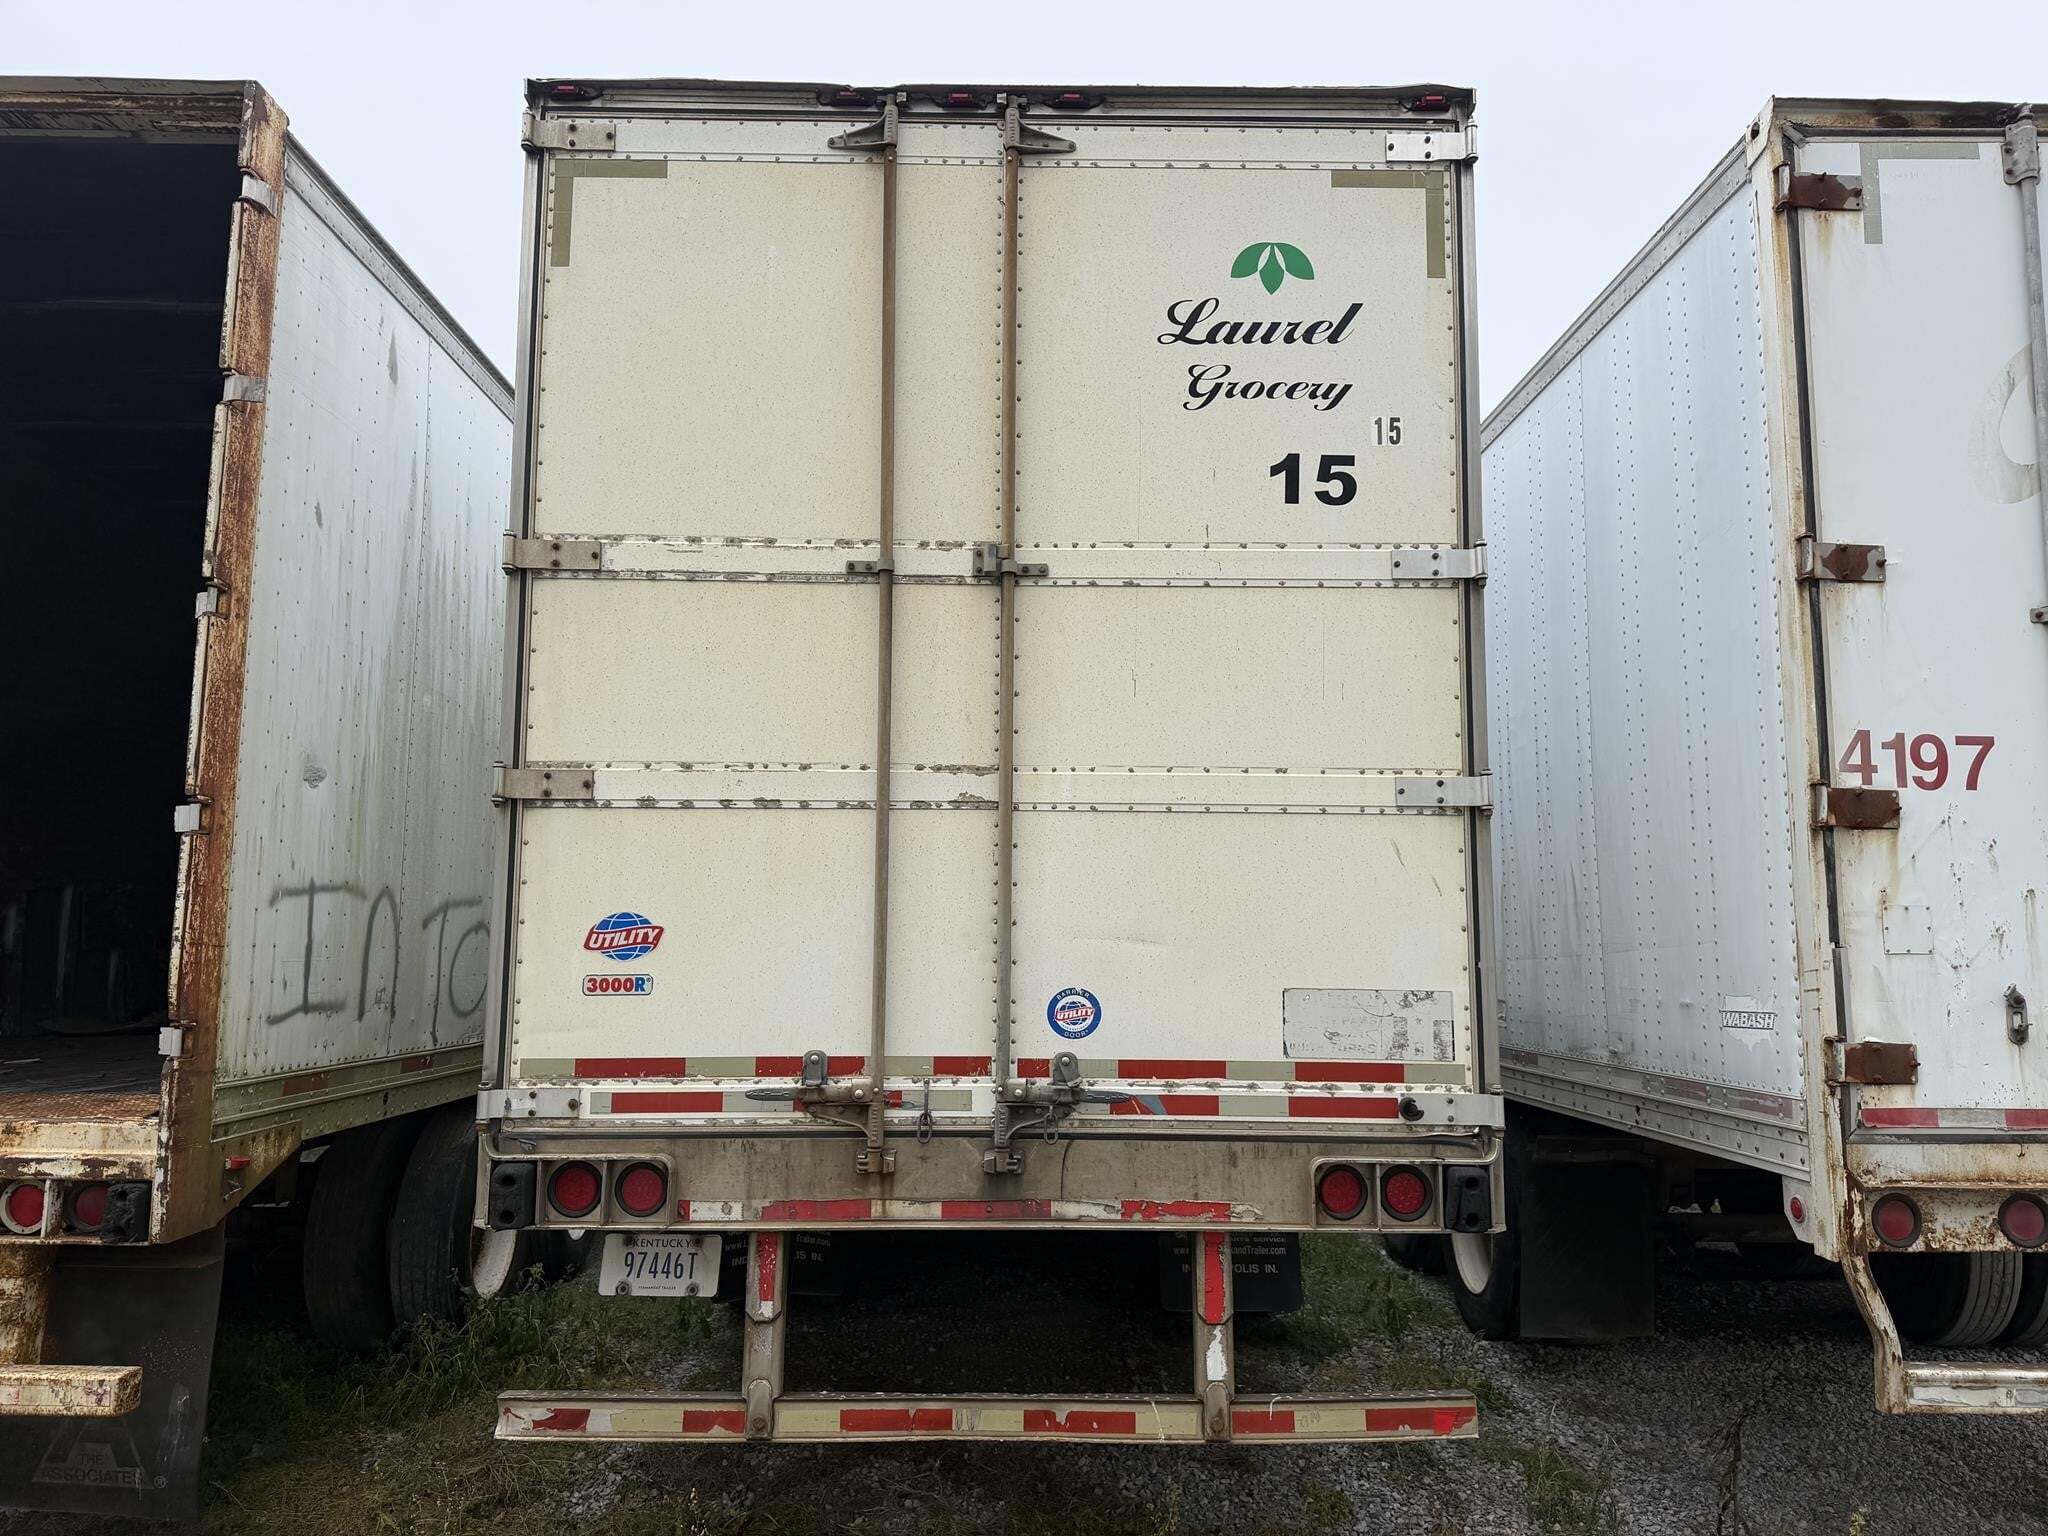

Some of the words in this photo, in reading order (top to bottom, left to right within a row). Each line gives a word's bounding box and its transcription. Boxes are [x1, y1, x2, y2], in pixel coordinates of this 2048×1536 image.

[1157, 297, 1364, 345] Laurel
[1183, 364, 1353, 411] Grocery
[1374, 417, 1401, 446] 15
[1269, 453, 1358, 505] 15
[1839, 729, 1995, 791] 4197
[589, 928, 660, 948] UTILITY
[1056, 1008, 1094, 1020] UTILITY
[1722, 1012, 1774, 1028] WABASH
[632, 1237, 692, 1248] KENTUCKY
[624, 1251, 698, 1279] 97446T
[79, 1453, 104, 1466] THE
